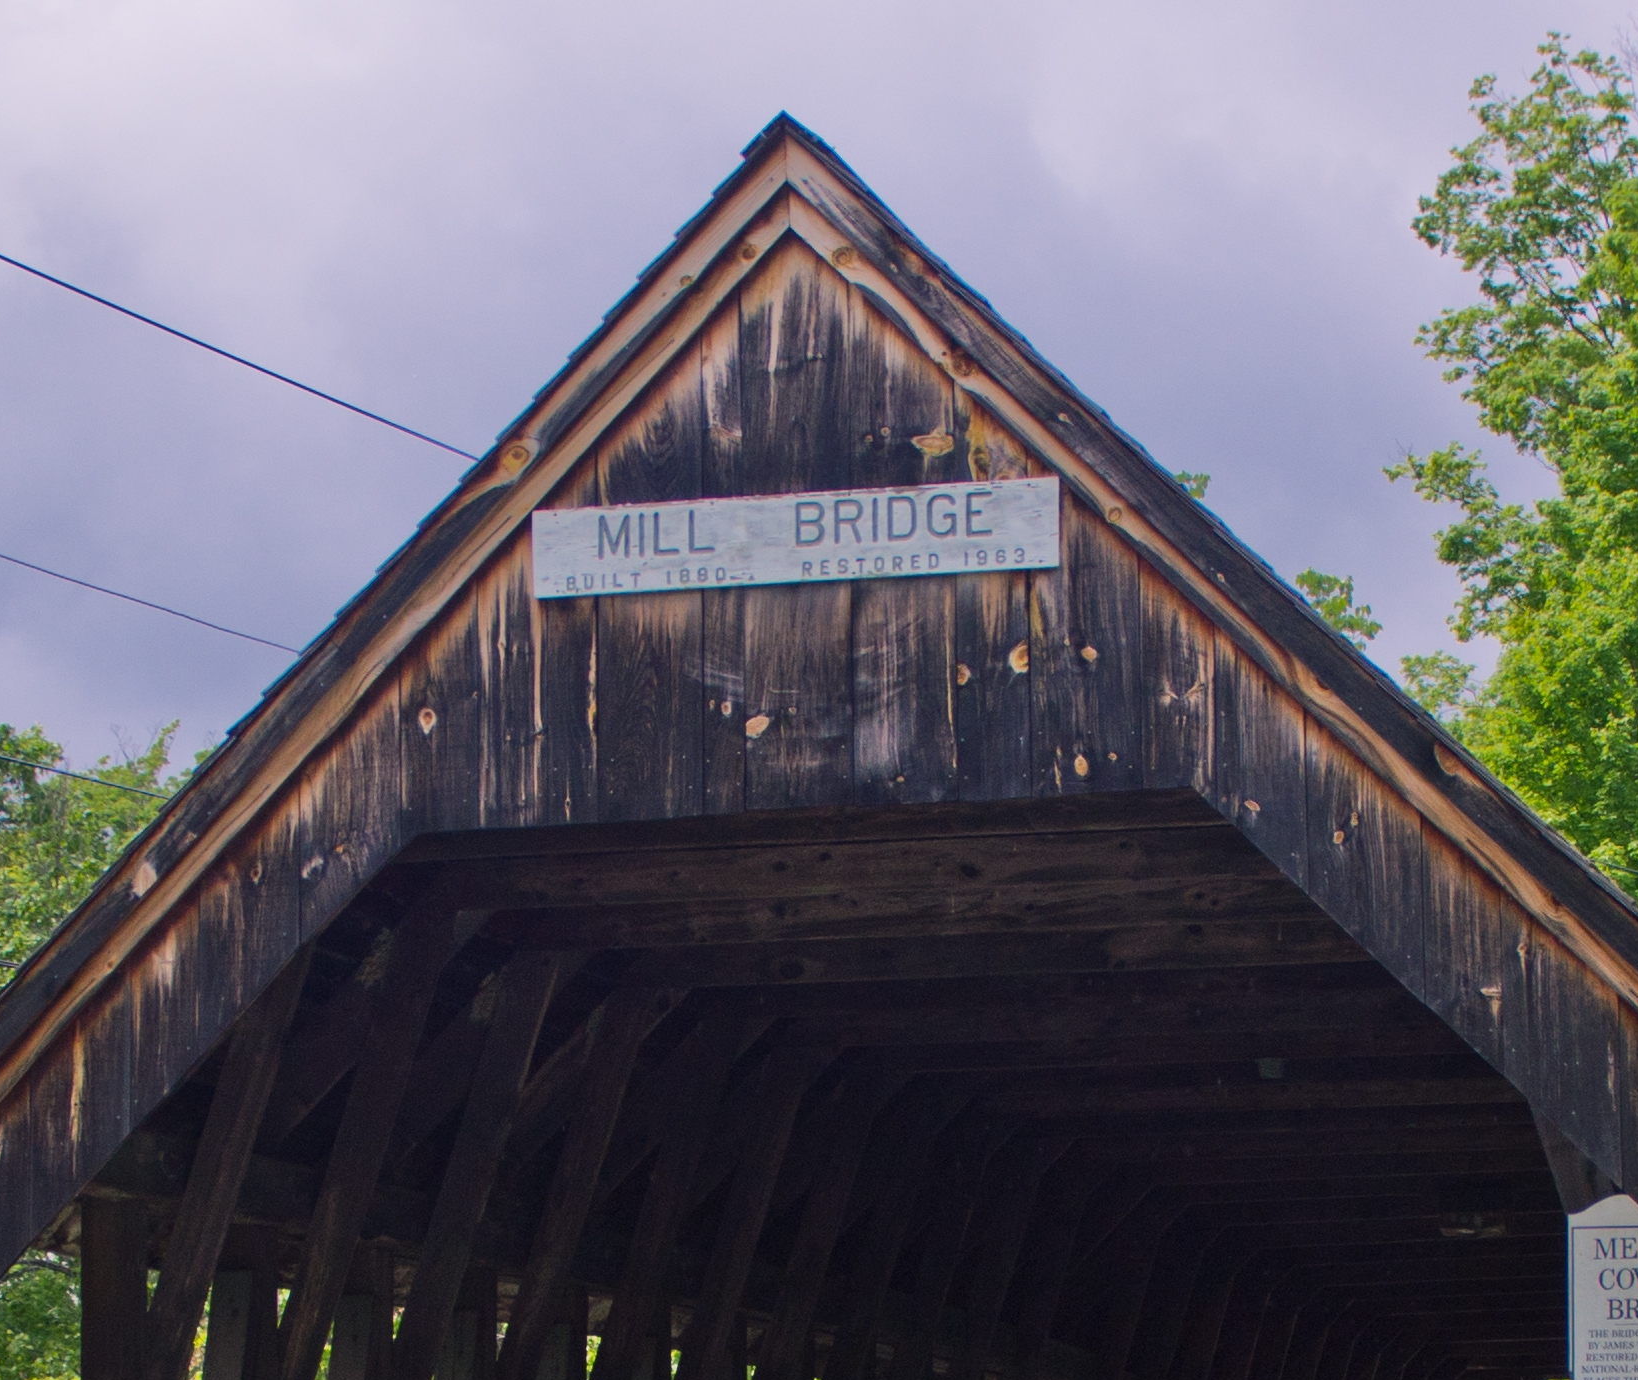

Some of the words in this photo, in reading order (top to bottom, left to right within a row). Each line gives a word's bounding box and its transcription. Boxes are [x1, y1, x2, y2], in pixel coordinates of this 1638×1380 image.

[597, 509, 716, 559] MILL
[794, 490, 994, 547] BRIDGE
[566, 572, 641, 591] BUILT
[801, 553, 940, 577] RESTORED
[964, 548, 1026, 566] 1963
[1588, 1329, 1609, 1338] THE
[1588, 1341, 1600, 1350] BY
[1603, 1341, 1634, 1349] JAMES
[1586, 1352, 1638, 1361] RESTORED
[1581, 1364, 1631, 1373] NATIONAL
